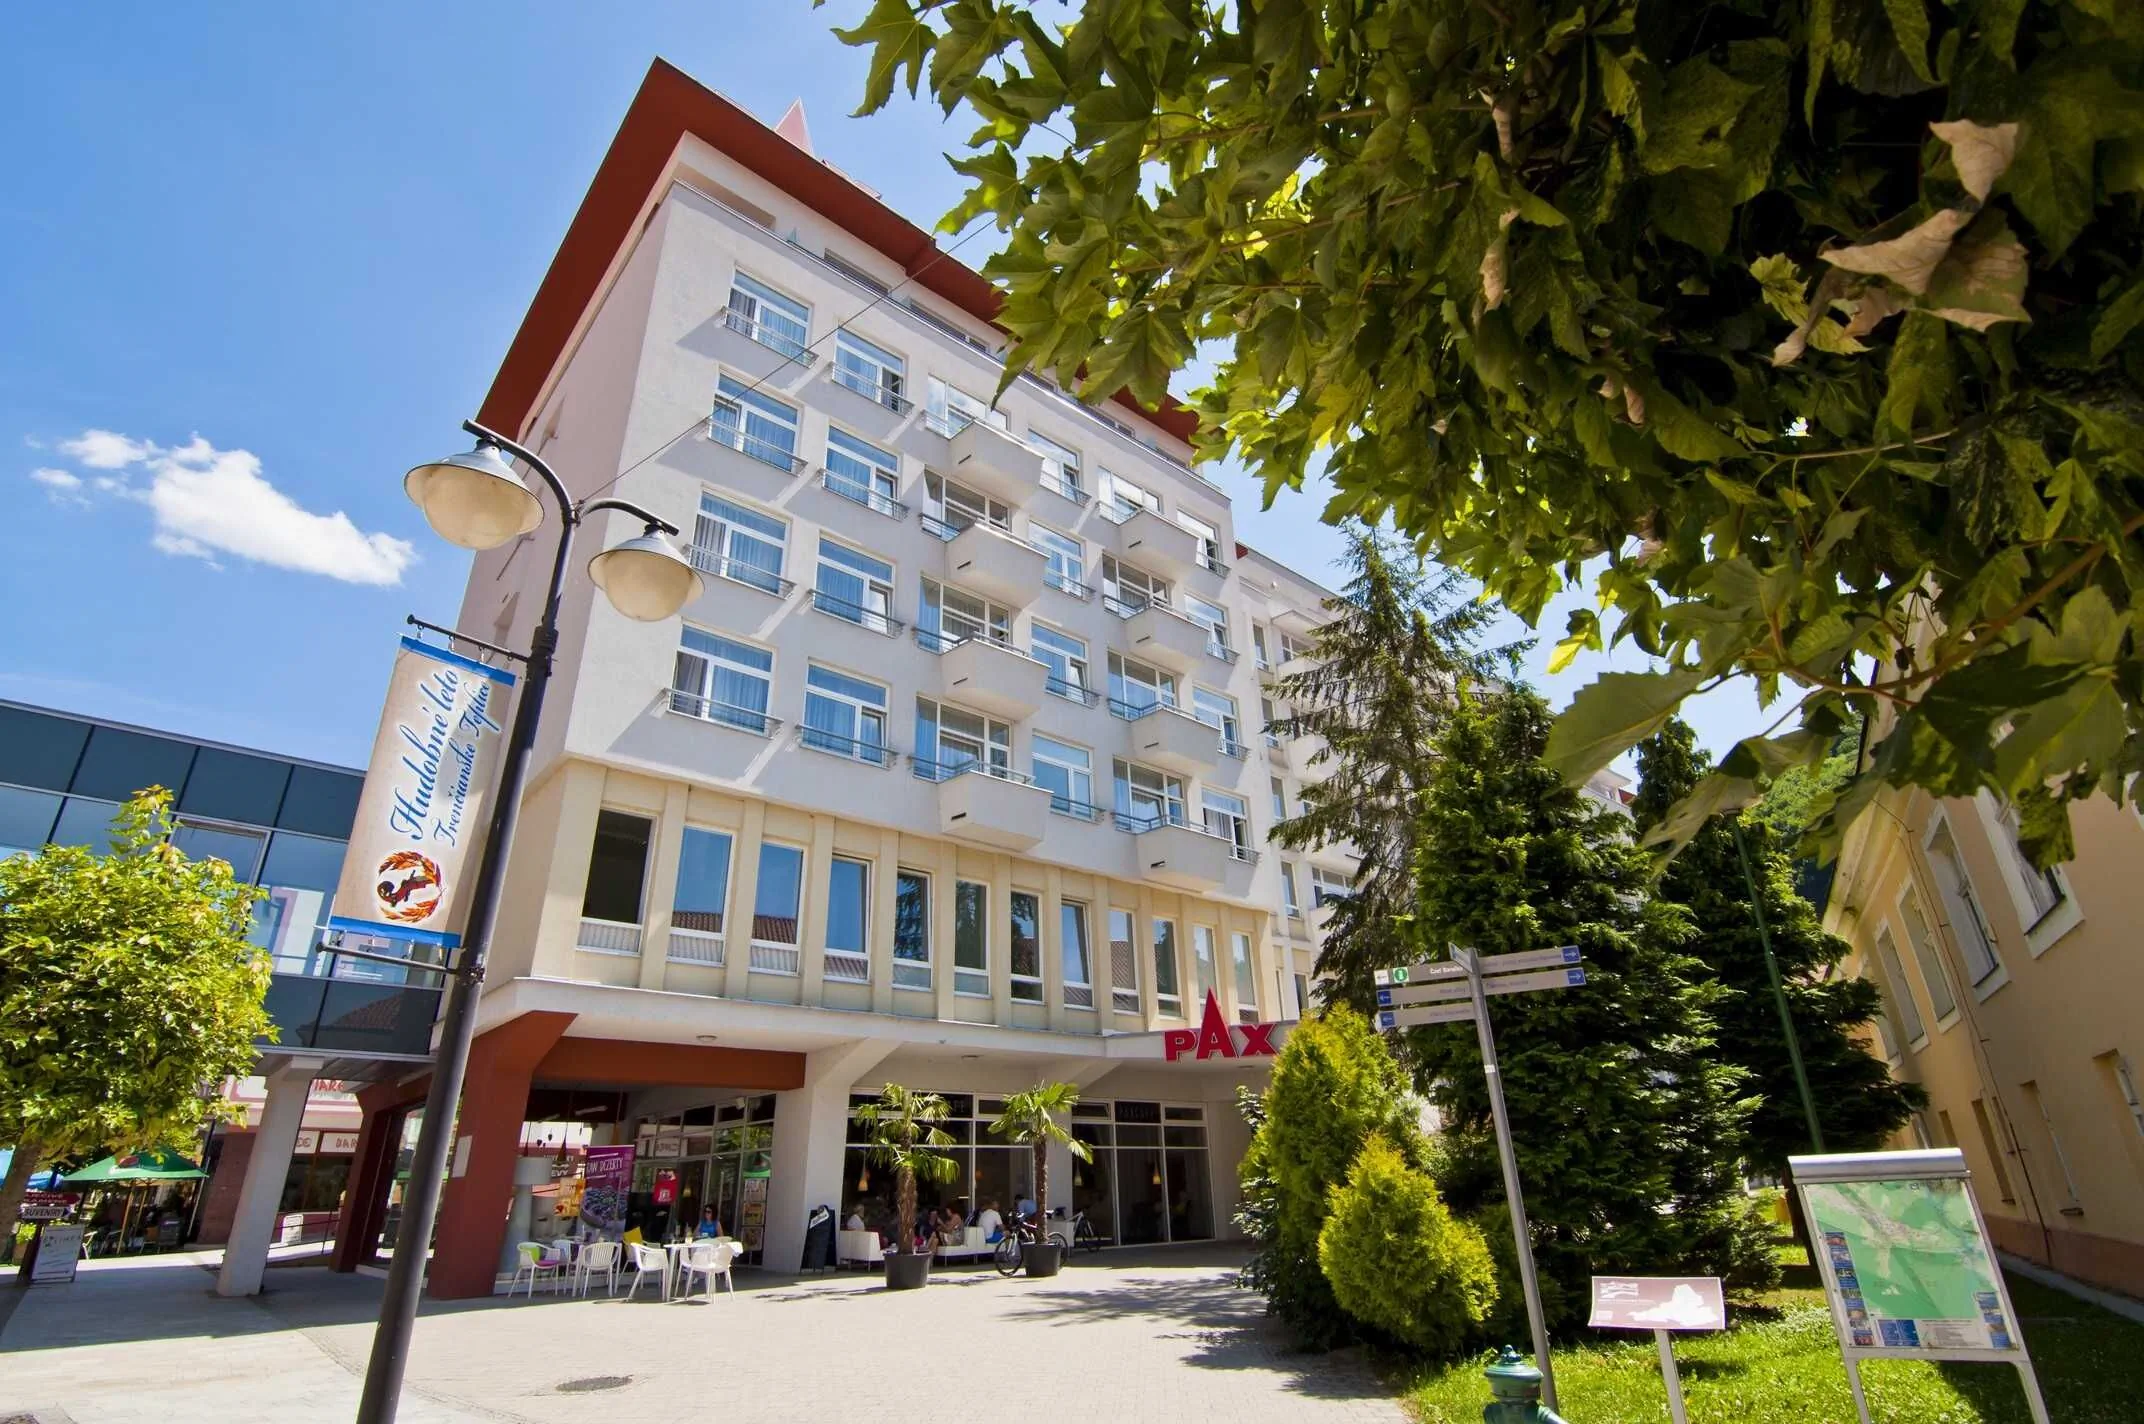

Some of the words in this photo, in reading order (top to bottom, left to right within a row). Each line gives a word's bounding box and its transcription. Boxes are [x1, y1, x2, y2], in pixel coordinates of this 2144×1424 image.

[390, 706, 449, 841] Hudobné
[420, 670, 459, 712] leto
[433, 737, 477, 848] Trenčianske
[458, 680, 500, 738] Teplice
[1164, 987, 1278, 1062] PAX
